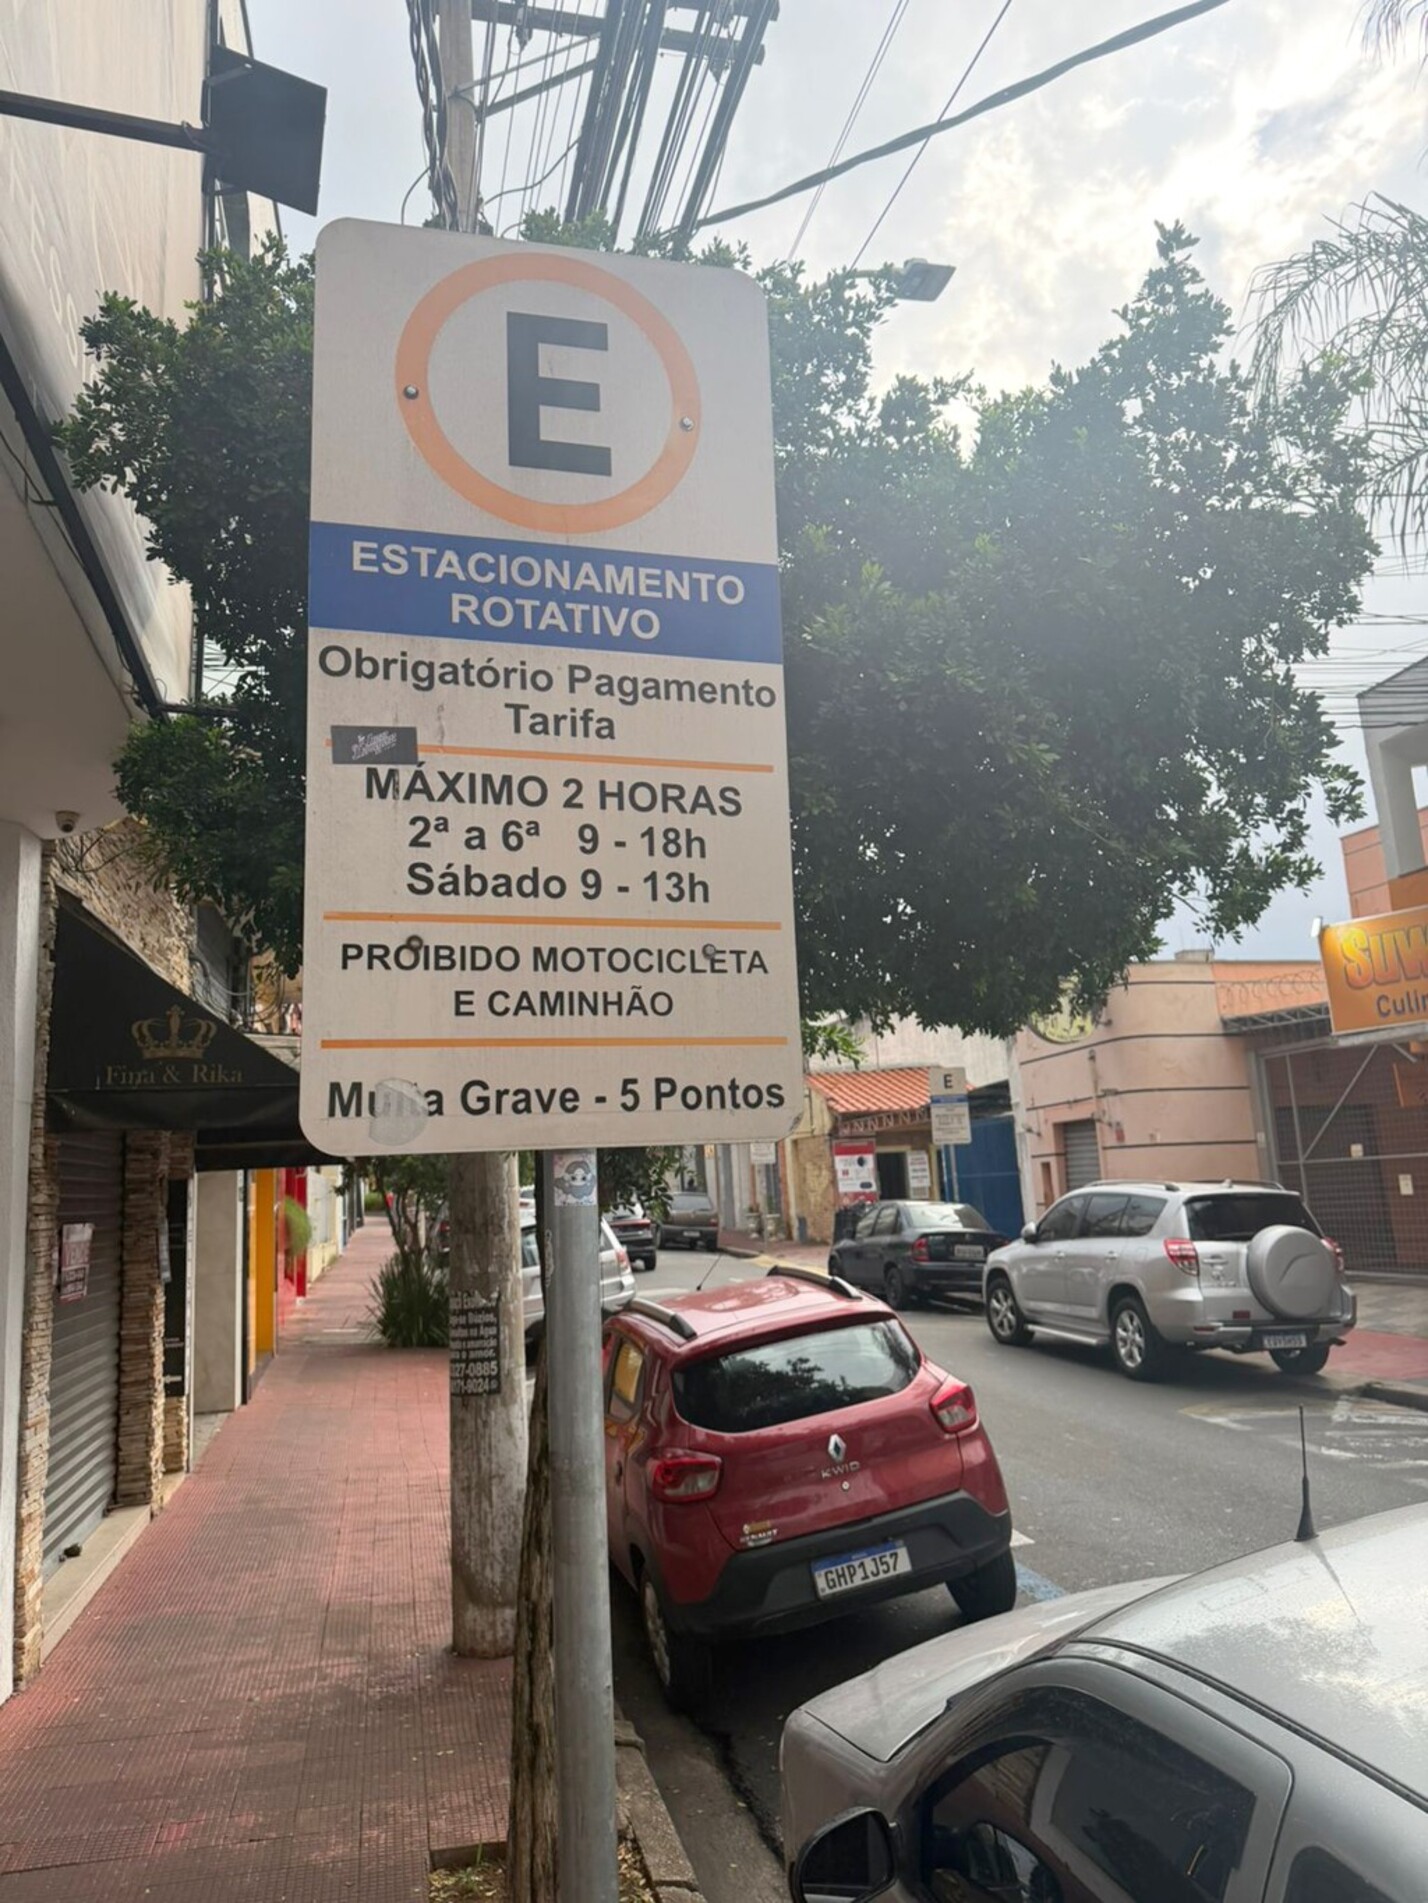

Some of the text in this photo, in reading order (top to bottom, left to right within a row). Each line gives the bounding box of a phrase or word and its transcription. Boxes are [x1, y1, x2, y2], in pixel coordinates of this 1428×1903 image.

[506, 311, 612, 477] E
[351, 541, 745, 605] ESTACIONAMENTO
[450, 592, 660, 640] ROTATIVO
[318, 645, 777, 708] Obrigatório Pagamento
[505, 703, 616, 739] Tarifa
[365, 761, 742, 817] MÁXIMO 2 HORAS
[408, 815, 449, 848] 2ª
[464, 825, 486, 851] a
[501, 820, 540, 852] 6ª
[577, 823, 600, 855] 9
[640, 826, 707, 859] 18h
[406, 862, 567, 898] Sábado
[580, 868, 602, 900] 9
[642, 870, 710, 903] 13h
[340, 943, 769, 975] PROIBIDO MOTOCICLETA
[453, 984, 674, 1017] E CAMINHÃO
[162, 1063, 182, 1084] &
[191, 1063, 243, 1083] Rika
[943, 1074, 954, 1089] E
[328, 1081, 444, 1118] Mua
[460, 1079, 580, 1116] Grave
[620, 1077, 640, 1113] 5
[653, 1076, 786, 1111] Pontos
[820, 1461, 861, 1479] KWID
[823, 1551, 899, 1591] GHP1J57
